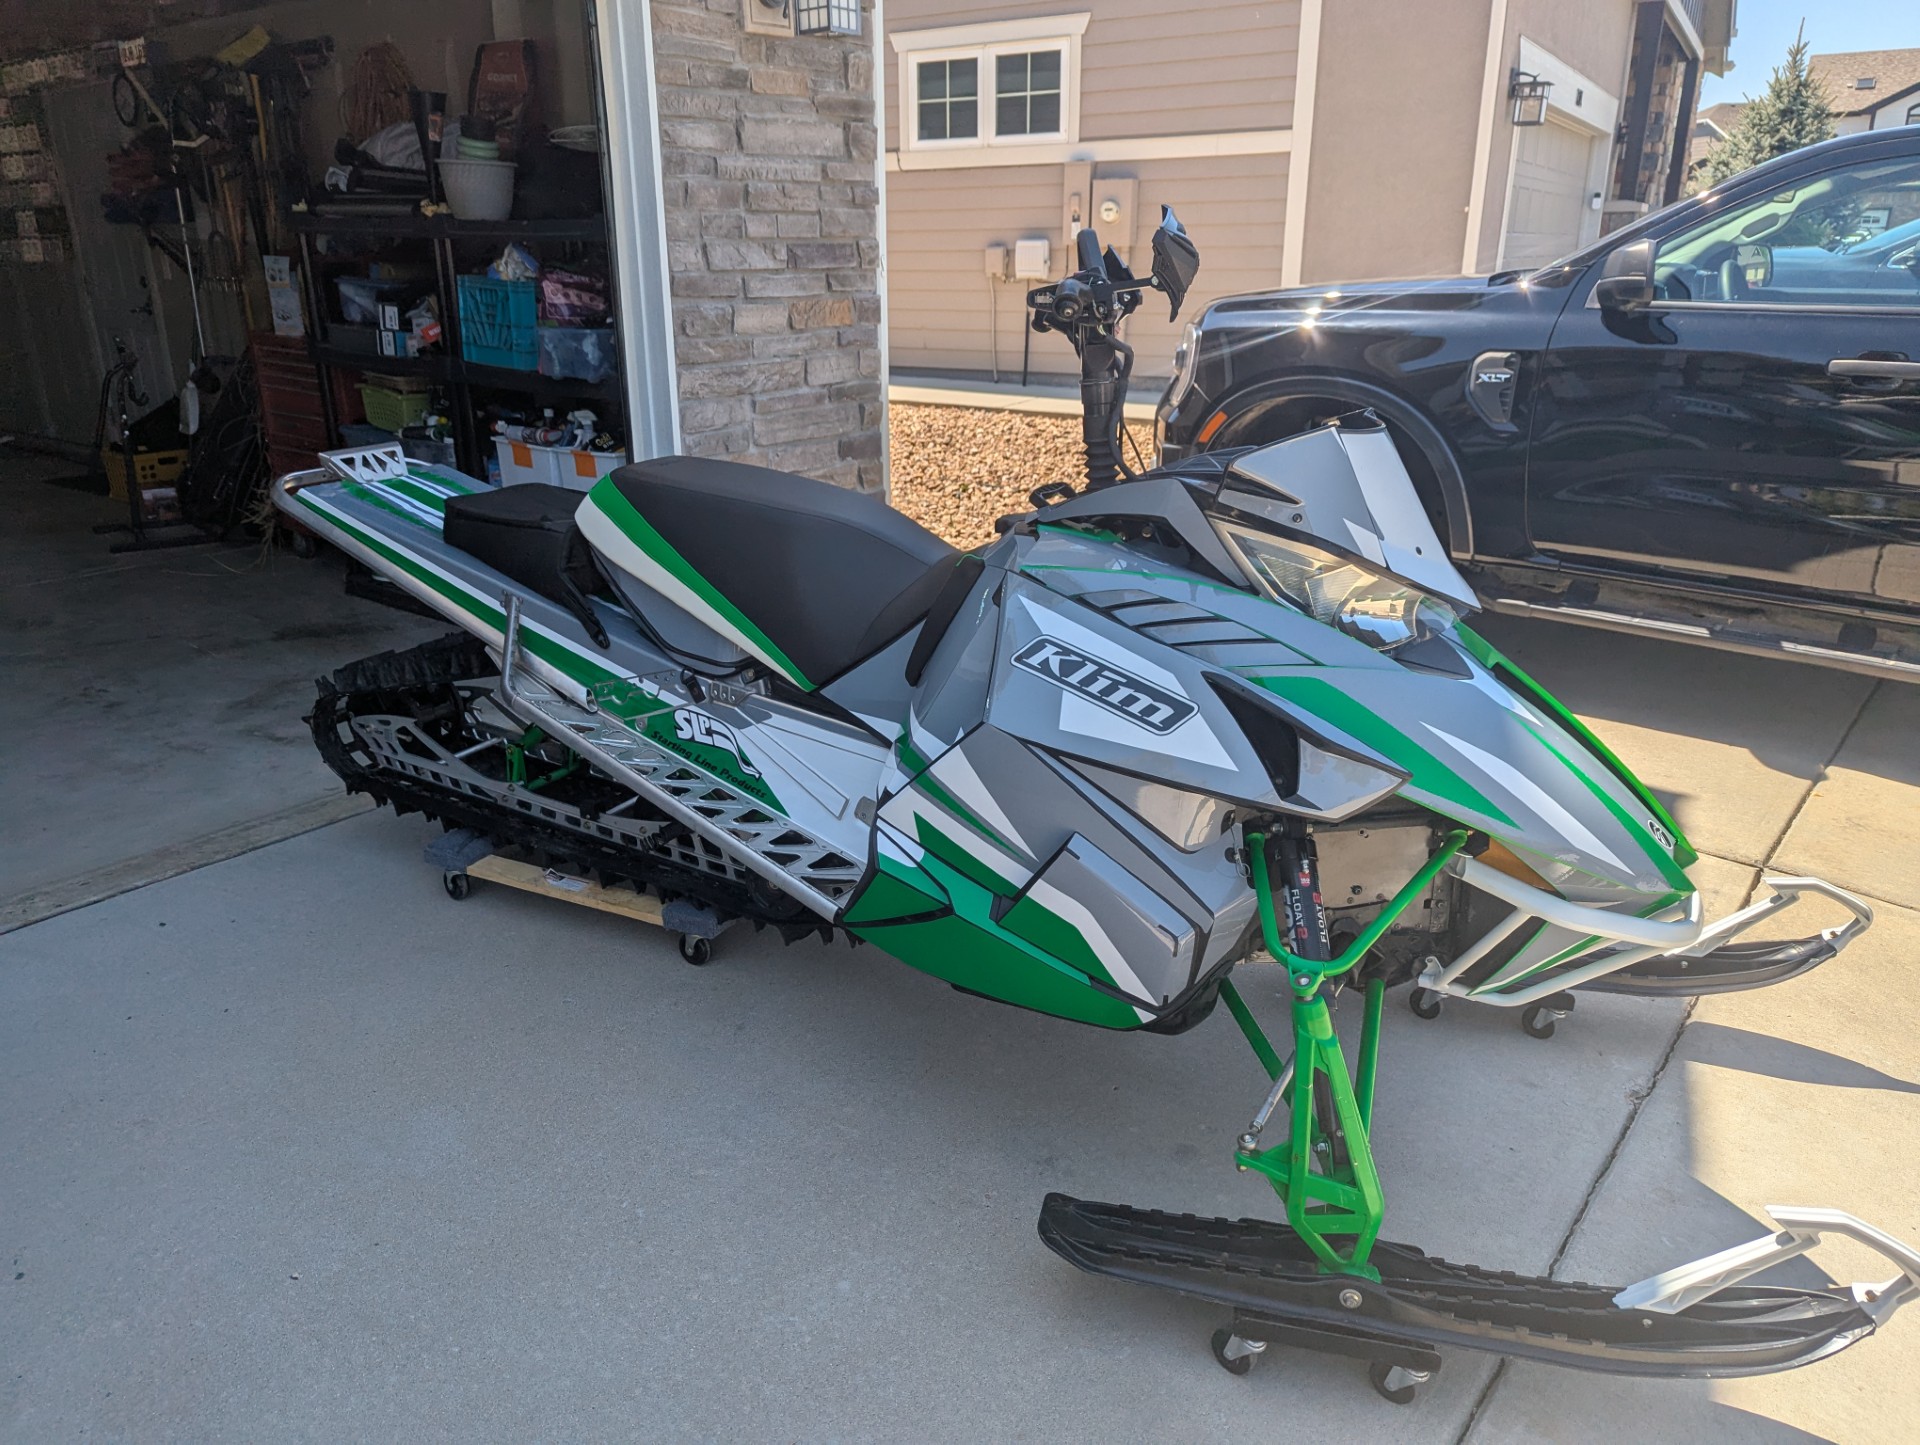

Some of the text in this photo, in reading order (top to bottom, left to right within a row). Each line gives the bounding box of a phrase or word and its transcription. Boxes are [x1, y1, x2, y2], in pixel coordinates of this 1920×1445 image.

[1476, 373, 1511, 383] XLT
[673, 708, 715, 746] SLP
[651, 730, 767, 798] Starting Line Products
[1291, 889, 1304, 927] FLOAT
[1316, 903, 1327, 943] FLOAT
